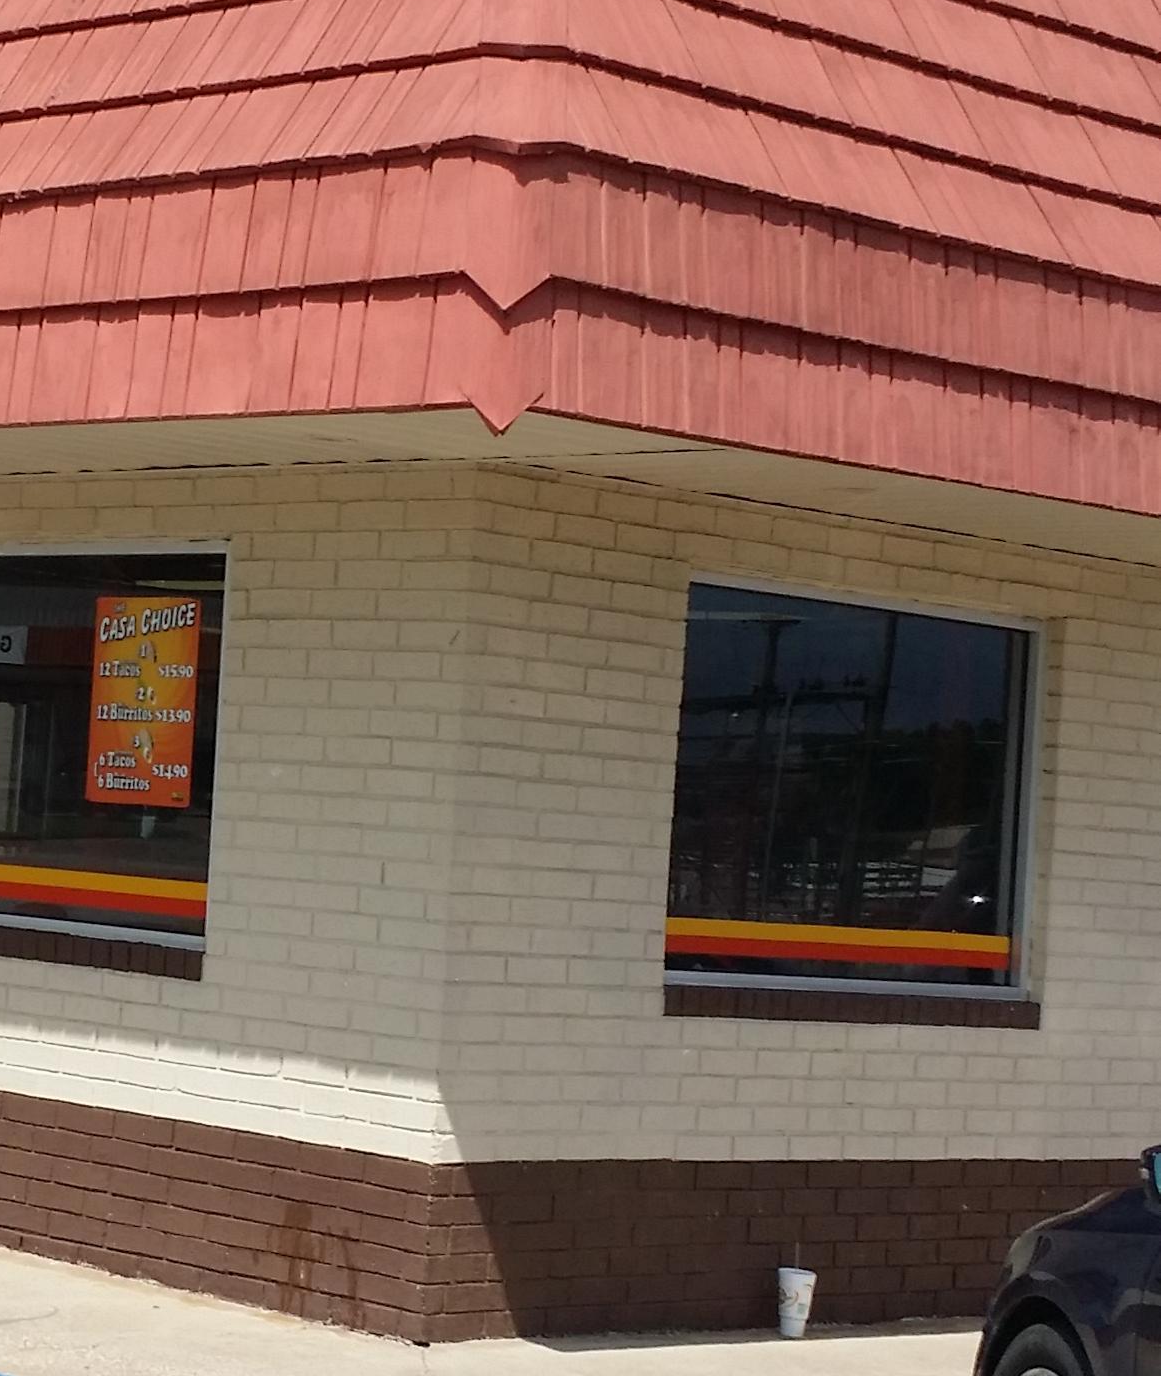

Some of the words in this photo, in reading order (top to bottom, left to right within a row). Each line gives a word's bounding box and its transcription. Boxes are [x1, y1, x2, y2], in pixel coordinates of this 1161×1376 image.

[100, 615, 136, 642] CASA
[141, 603, 196, 635] CHOICE
[99, 662, 111, 677] 12
[112, 660, 142, 677] Tacos
[97, 704, 109, 720] 12
[110, 703, 152, 721] Burritos
[107, 752, 137, 768] Tacos
[106, 772, 150, 791] Burritos
